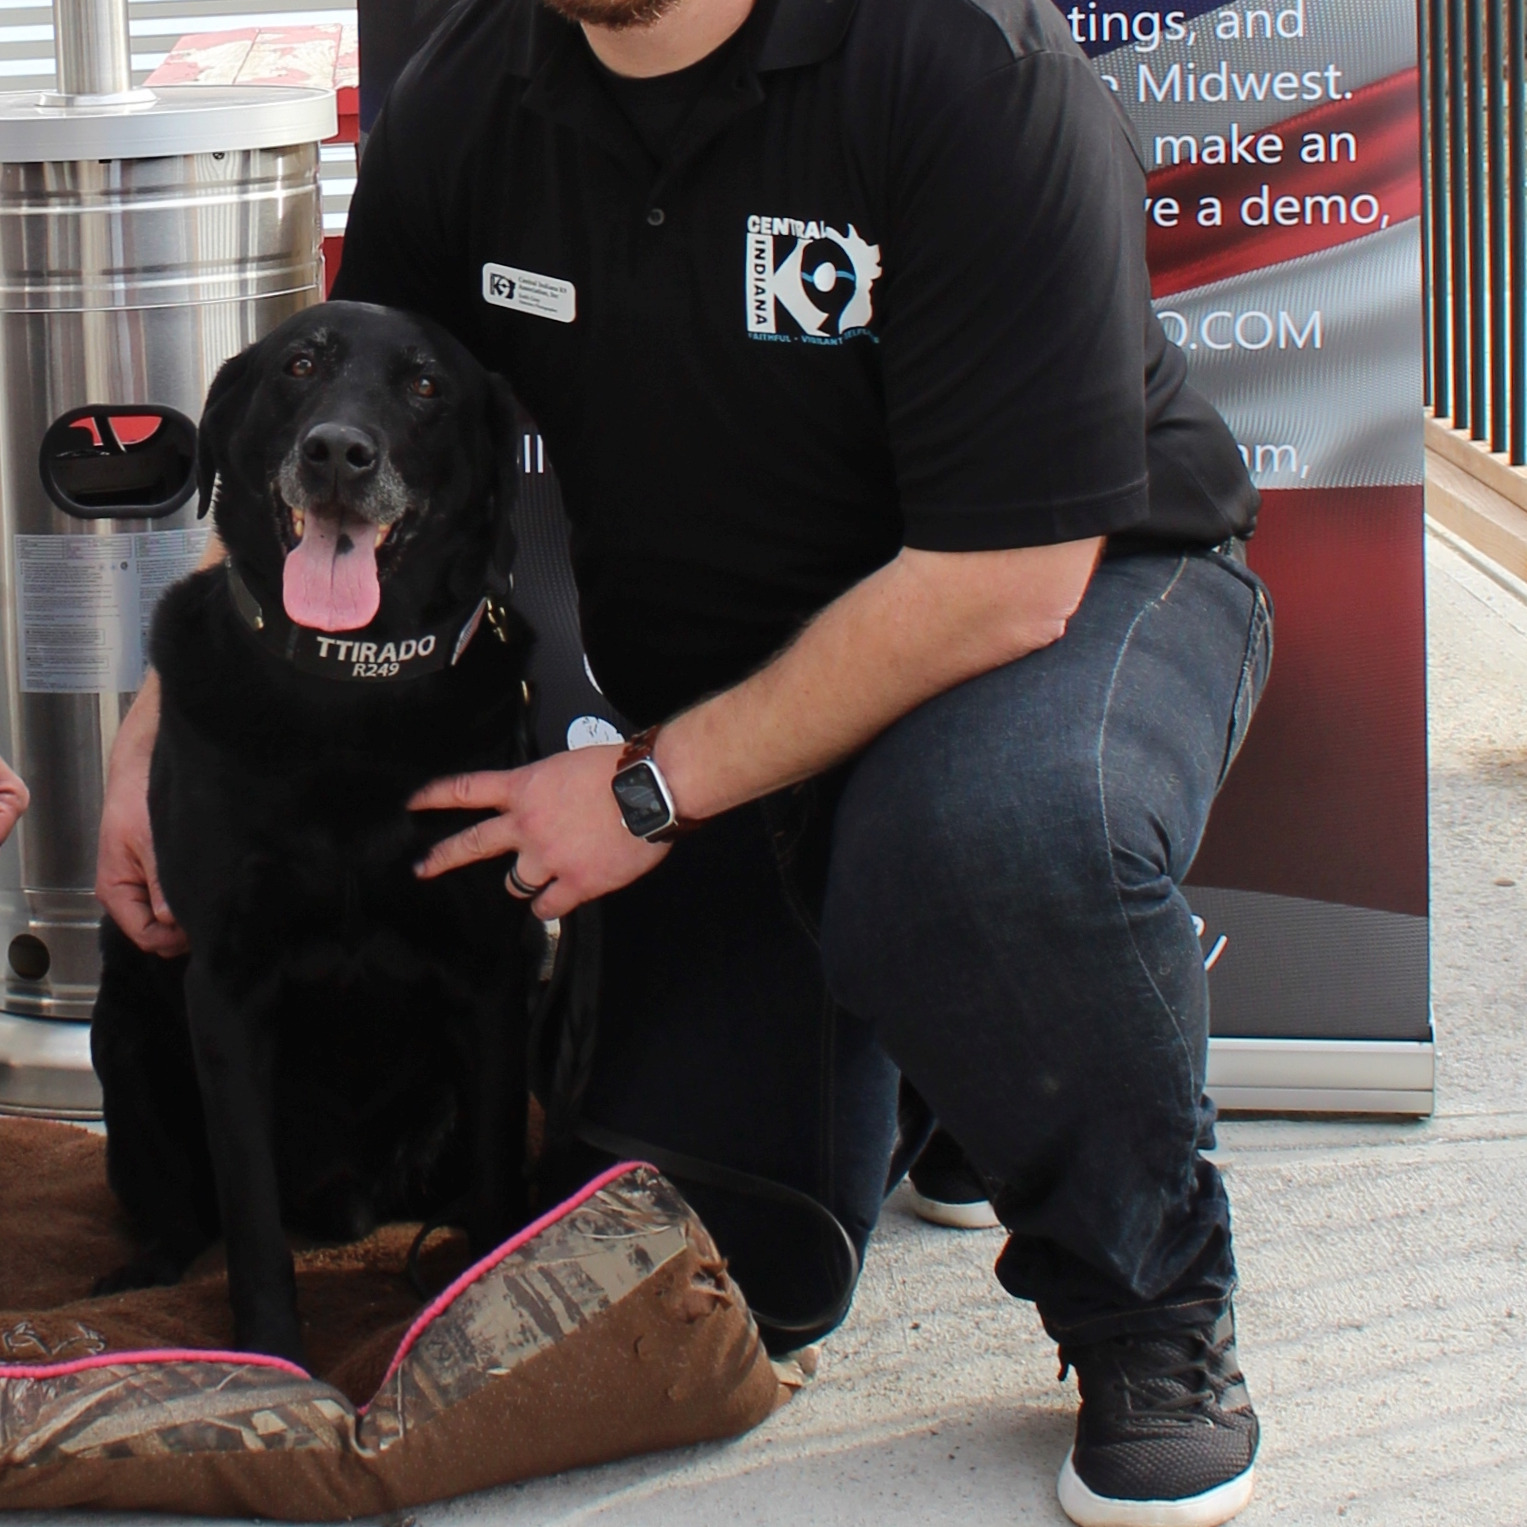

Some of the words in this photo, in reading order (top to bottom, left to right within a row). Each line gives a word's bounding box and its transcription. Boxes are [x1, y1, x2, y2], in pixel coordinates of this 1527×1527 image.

[1066, 1, 1197, 53] tings,
[1137, 60, 1354, 103] Midwest.
[1154, 123, 1284, 165] make
[1300, 131, 1357, 163] an
[747, 214, 827, 240] CENTRAL
[1196, 196, 1222, 227] a
[1240, 184, 1390, 230] demo,
[754, 239, 768, 325] INDIANA
[316, 635, 436, 664] TTIRADO
[352, 663, 400, 677] R249
